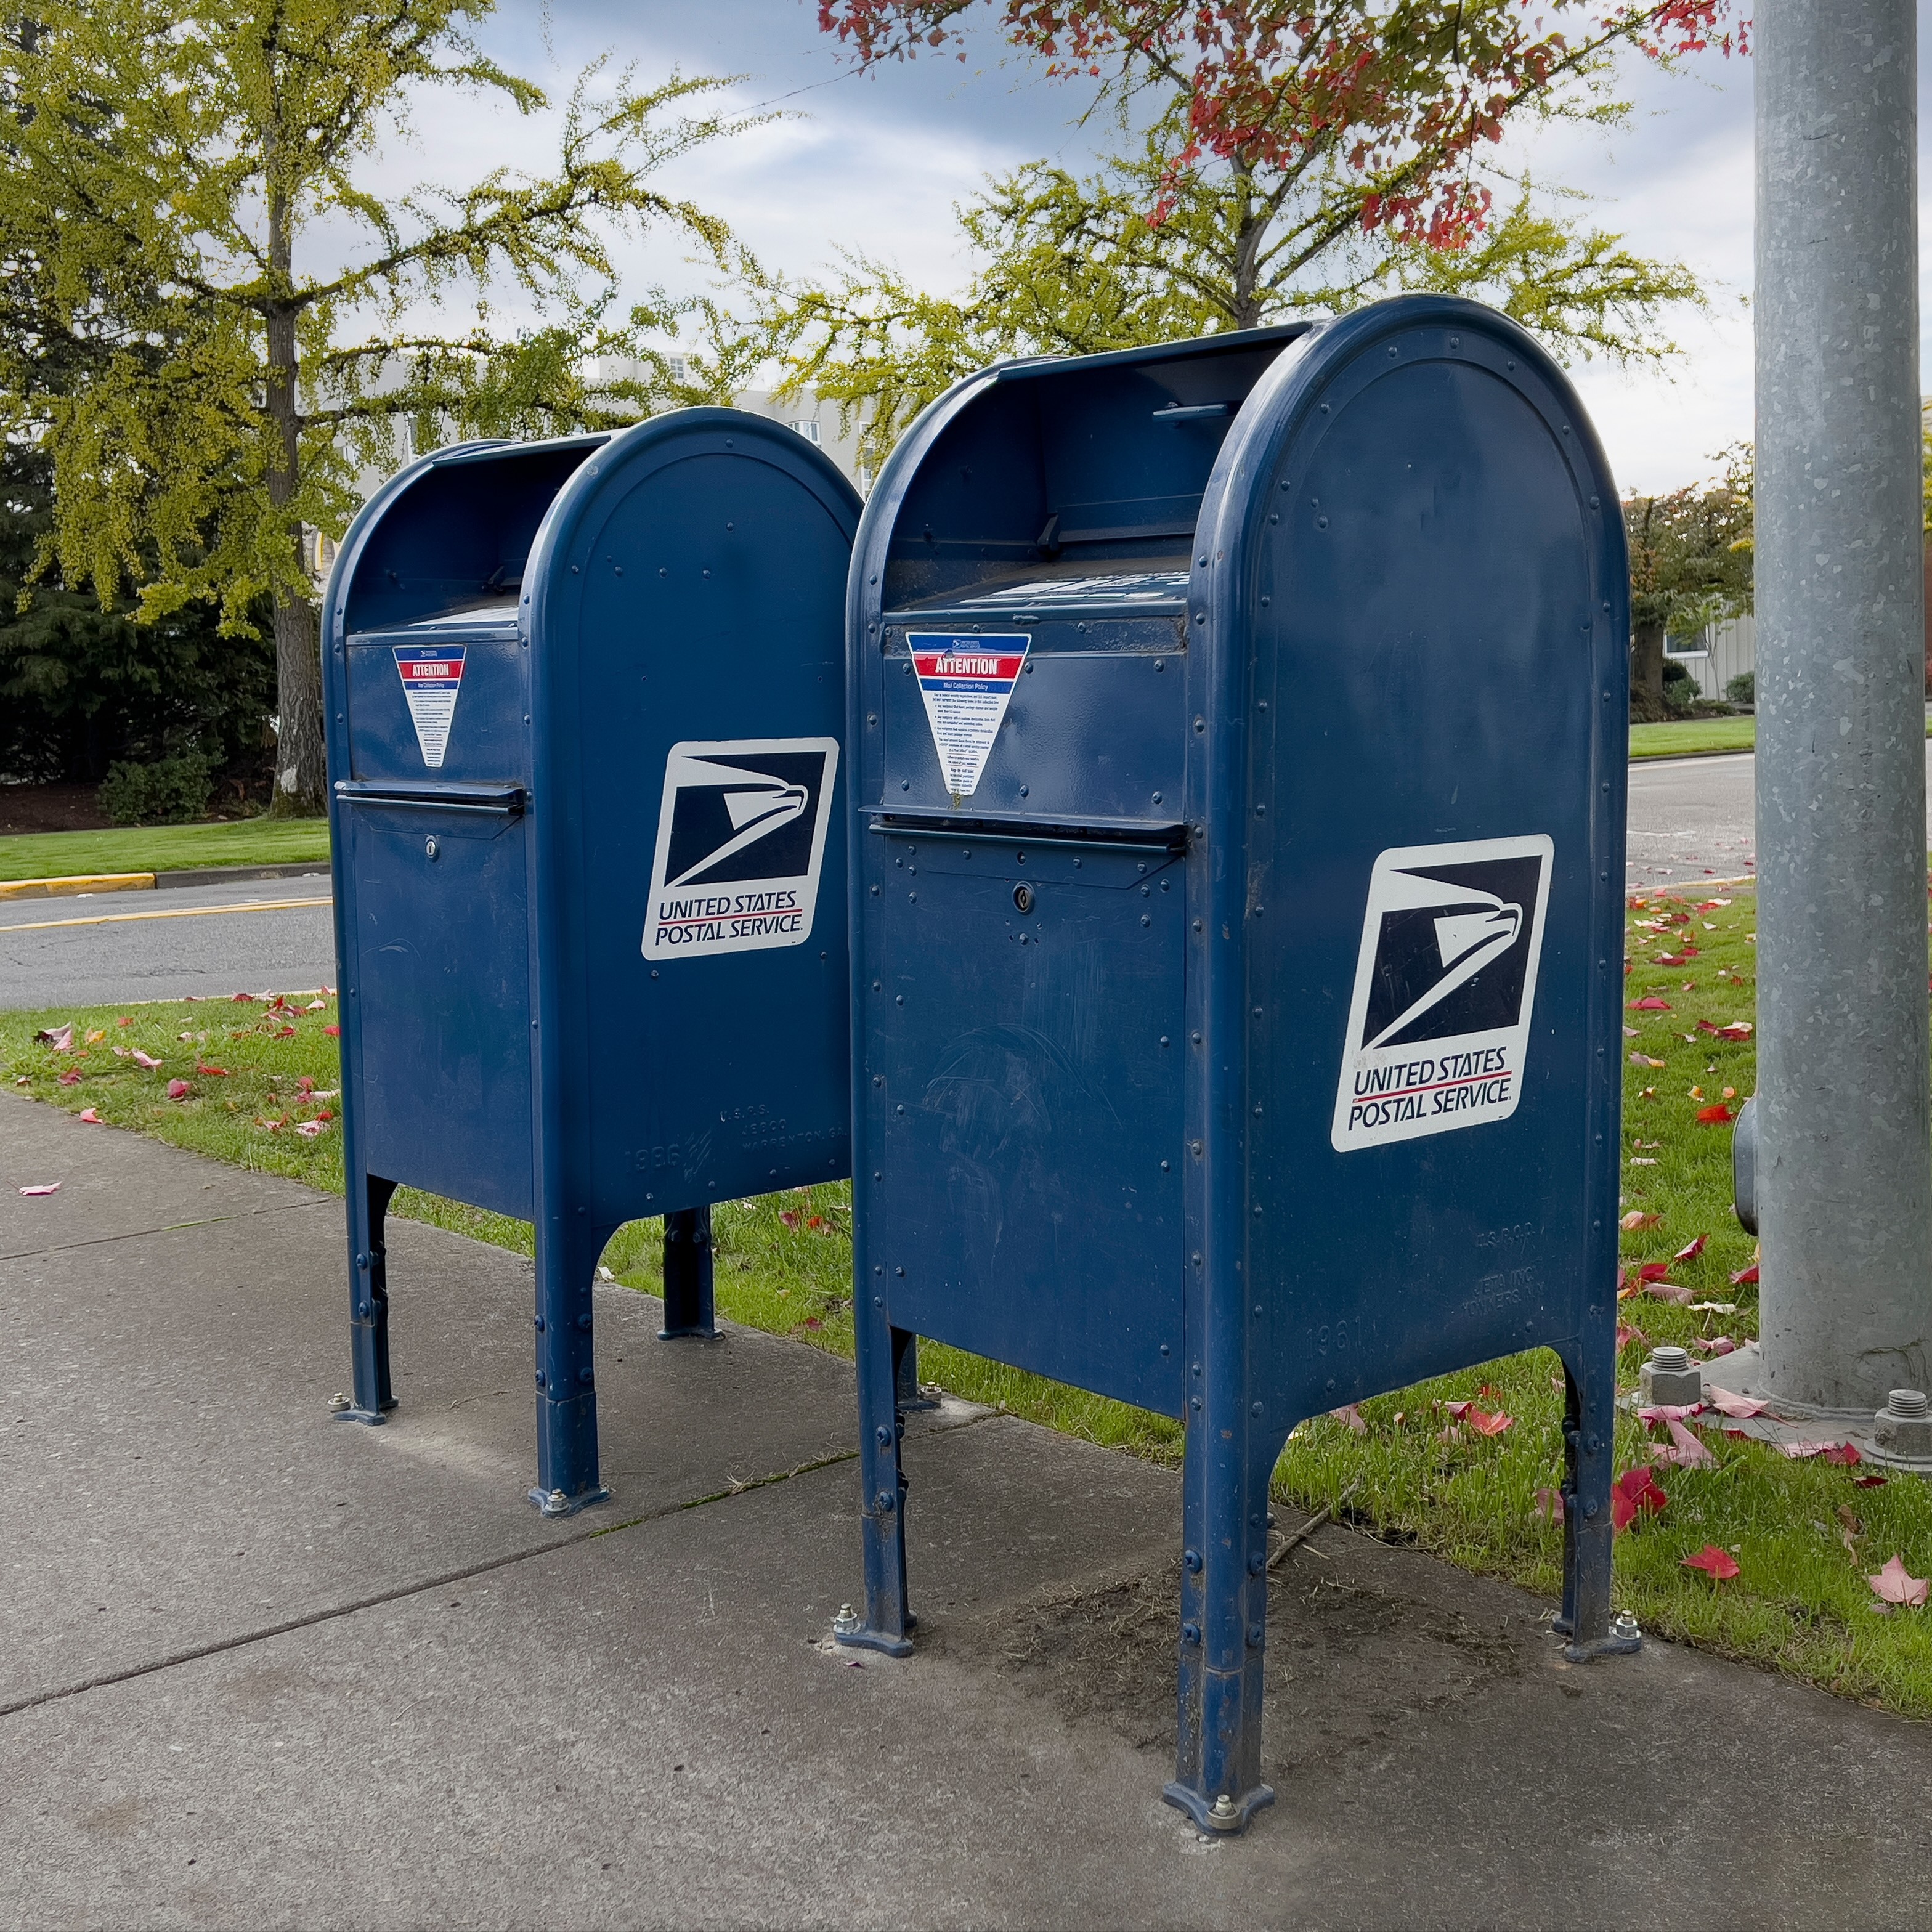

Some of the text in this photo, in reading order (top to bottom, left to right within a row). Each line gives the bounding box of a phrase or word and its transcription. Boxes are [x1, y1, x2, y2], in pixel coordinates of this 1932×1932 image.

[412, 663, 449, 676] ATTENTION
[935, 657, 997, 675] ATTENTION
[659, 890, 797, 920] UNITED STATES
[656, 922, 726, 946] POSTAL
[1355, 1046, 1507, 1095] UNITED STATES
[1348, 1094, 1427, 1131] POSTAL
